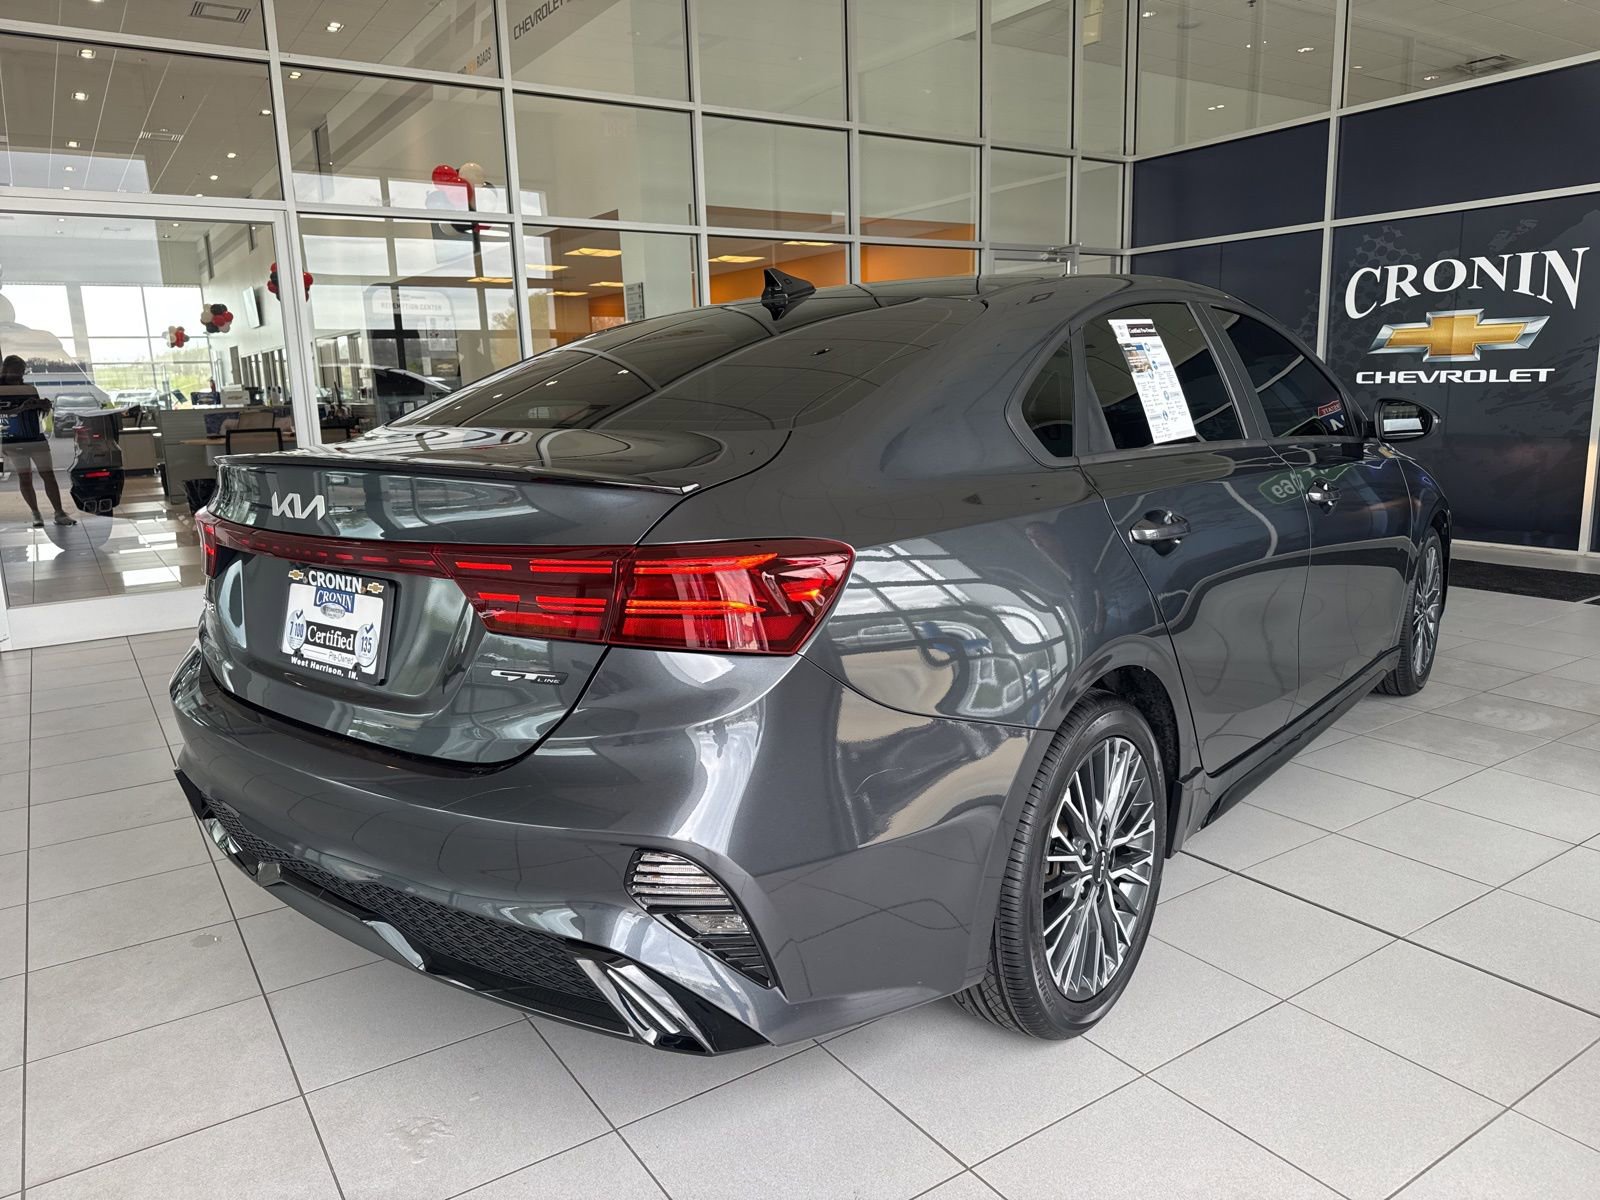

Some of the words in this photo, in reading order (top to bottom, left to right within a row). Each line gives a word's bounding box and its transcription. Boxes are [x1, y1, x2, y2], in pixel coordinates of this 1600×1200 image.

[1345, 247, 1590, 320] CRONIN
[1356, 368, 1555, 384] CHEVROLET
[271, 491, 326, 520] KIA
[308, 570, 363, 594] CRONIN
[316, 590, 354, 613] CRONIN
[307, 625, 354, 651] Certified
[291, 656, 309, 668] West
